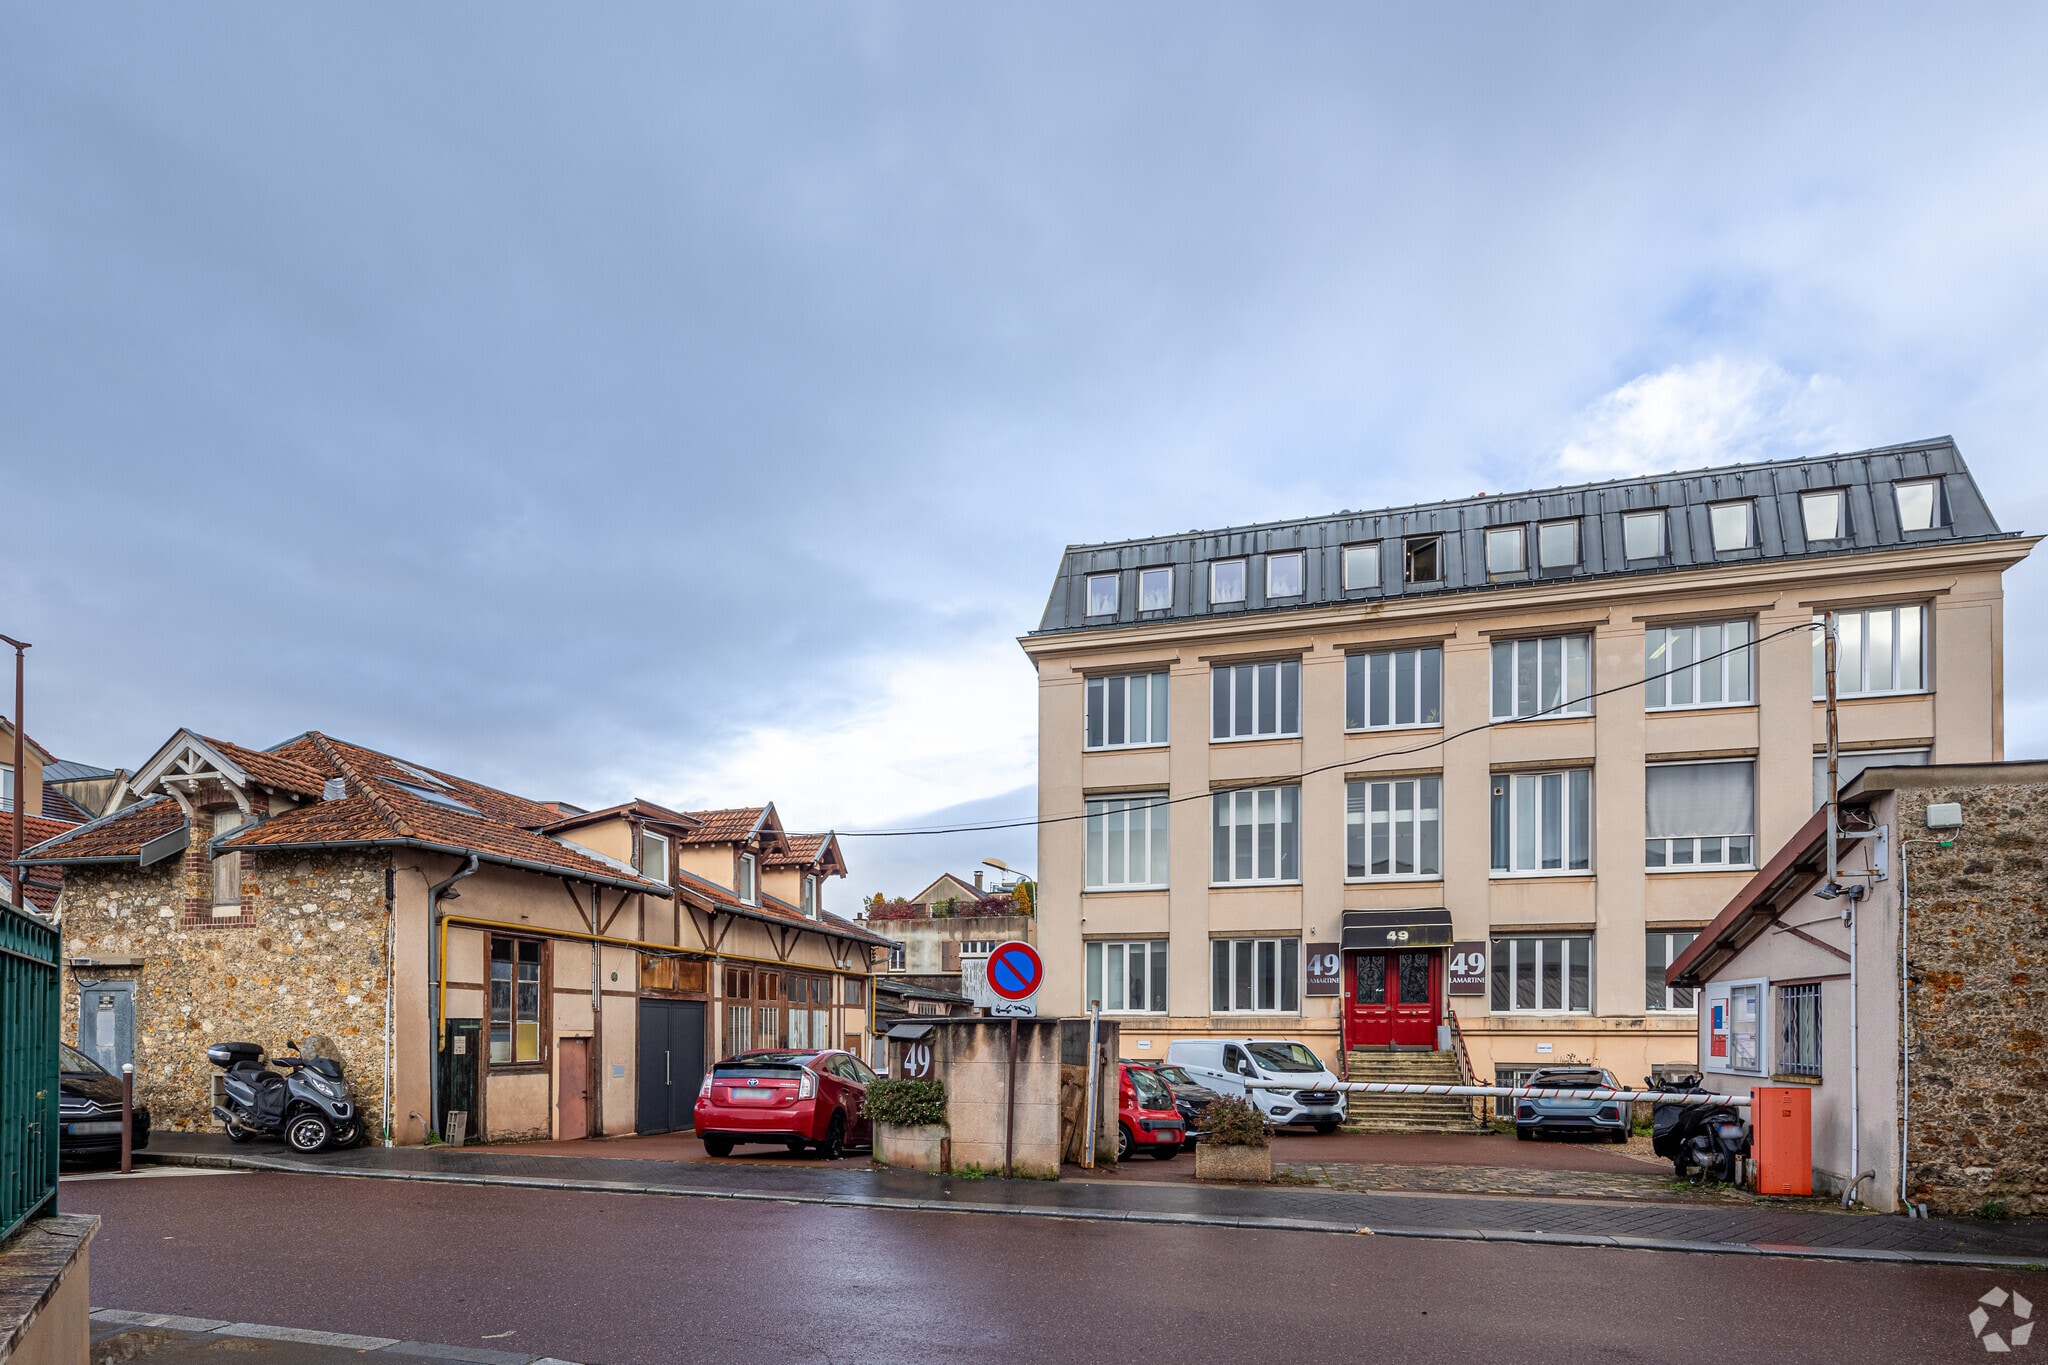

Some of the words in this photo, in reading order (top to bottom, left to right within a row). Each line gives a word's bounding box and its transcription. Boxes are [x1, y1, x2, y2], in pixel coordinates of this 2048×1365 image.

[1386, 930, 1409, 941] 49
[1307, 953, 1339, 976] 49
[1449, 952, 1485, 975] 49
[903, 1041, 931, 1077] 49
